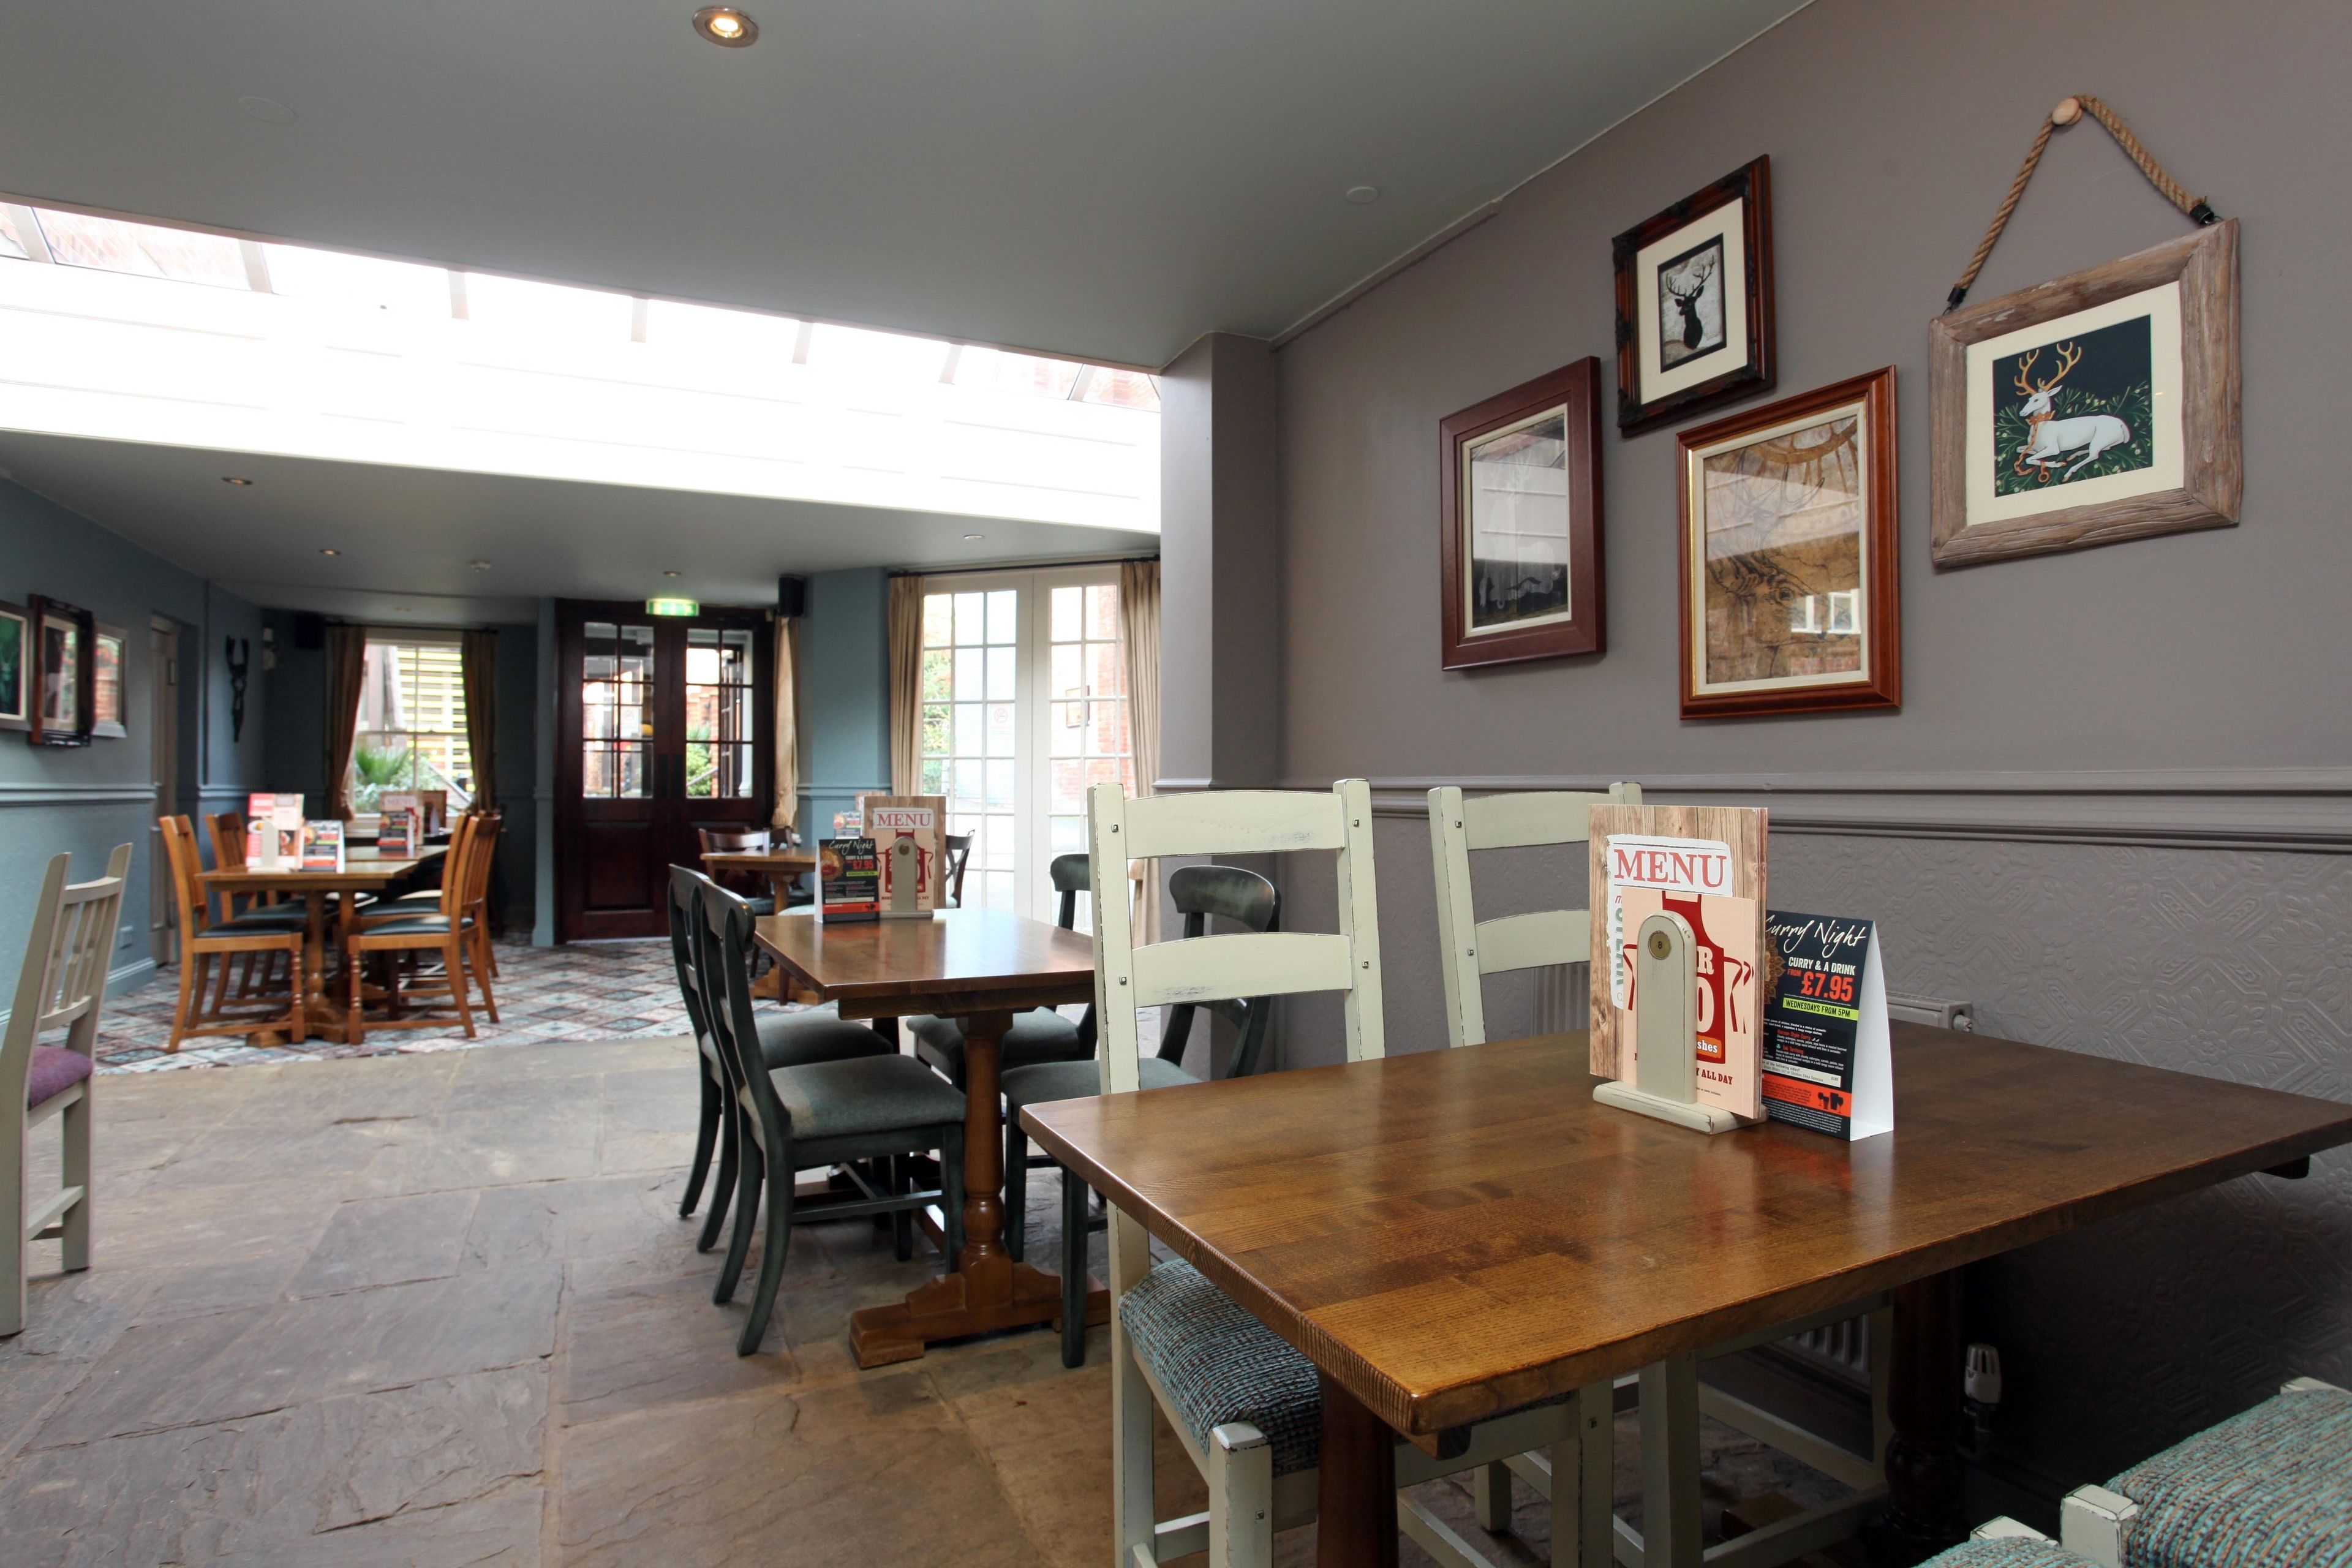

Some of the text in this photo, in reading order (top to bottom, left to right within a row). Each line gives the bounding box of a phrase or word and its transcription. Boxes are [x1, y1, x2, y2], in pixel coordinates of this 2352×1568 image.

[876, 813, 931, 827] MENU
[853, 839, 873, 855] Night
[1613, 849, 1727, 888] MENU
[1657, 940, 1662, 949] 8
[1814, 919, 1866, 958] Night
[1788, 956, 1856, 976] CURRY & A DRINK
[1801, 971, 1853, 1002] £7.95
[1785, 1000, 1820, 1012] WEDNESDAYS
[1822, 1006, 1837, 1015] FROM
[1838, 1009, 1850, 1017] 5PM
[1702, 1069, 1716, 1080] ALL
[1718, 1073, 1733, 1085] DAY
